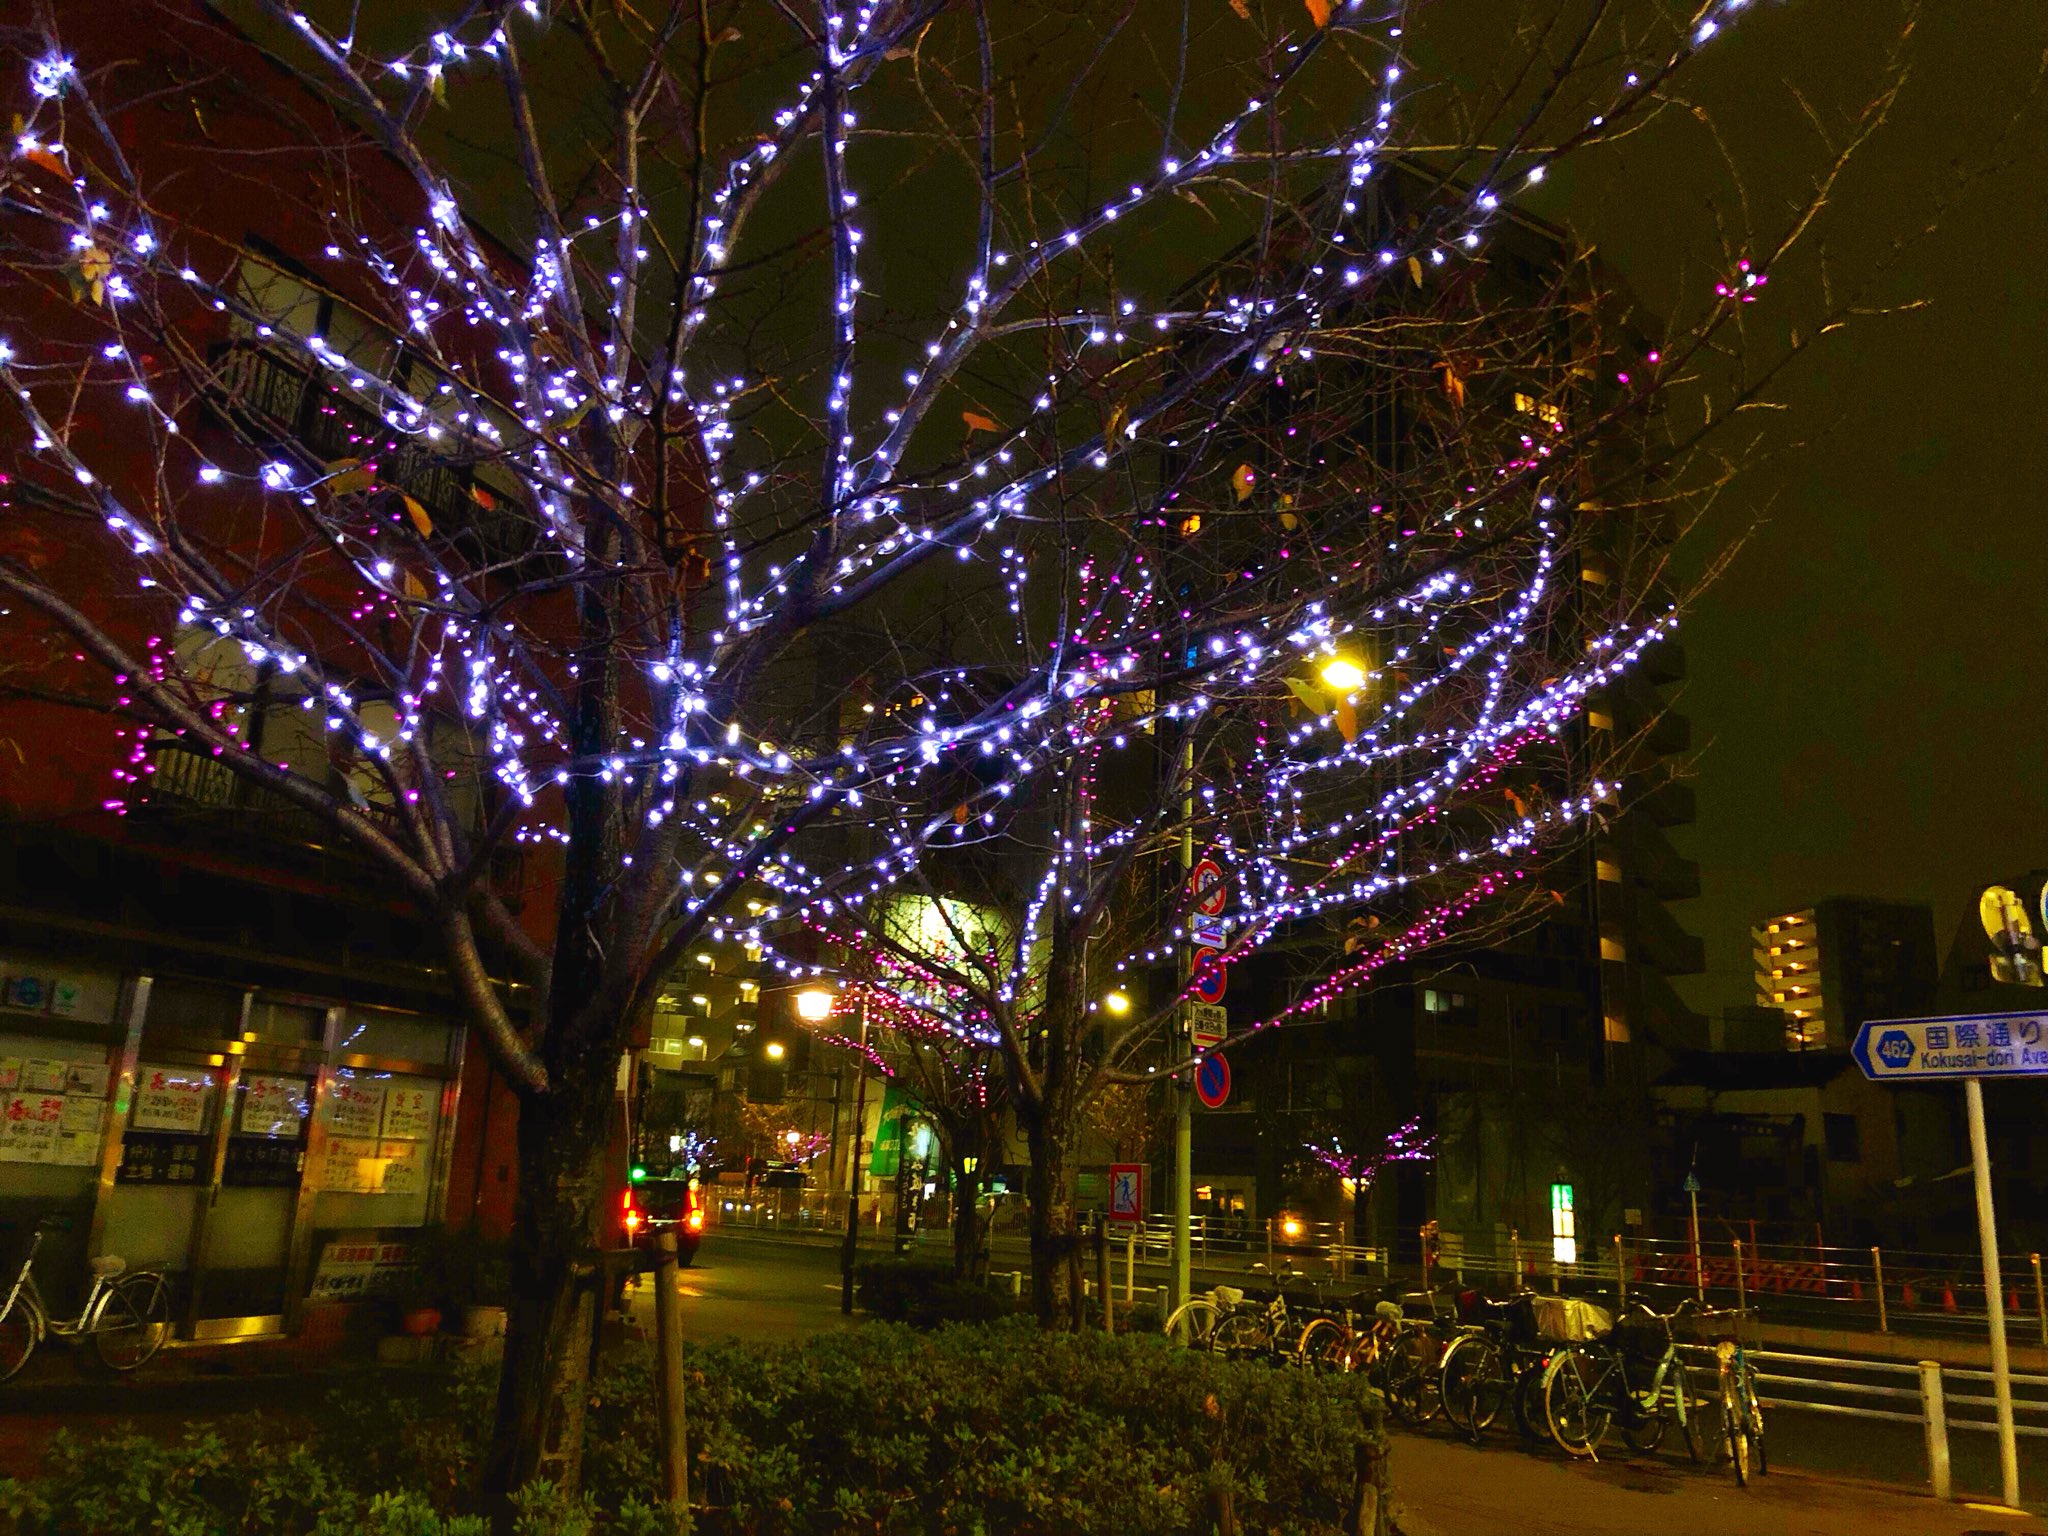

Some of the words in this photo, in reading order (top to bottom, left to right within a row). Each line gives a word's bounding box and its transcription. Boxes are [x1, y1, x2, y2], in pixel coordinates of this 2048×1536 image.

[1926, 1020, 2041, 1049] 国際通り
[1882, 1040, 1911, 1058] 462
[1921, 1049, 2015, 1069] Kokusai-dori
